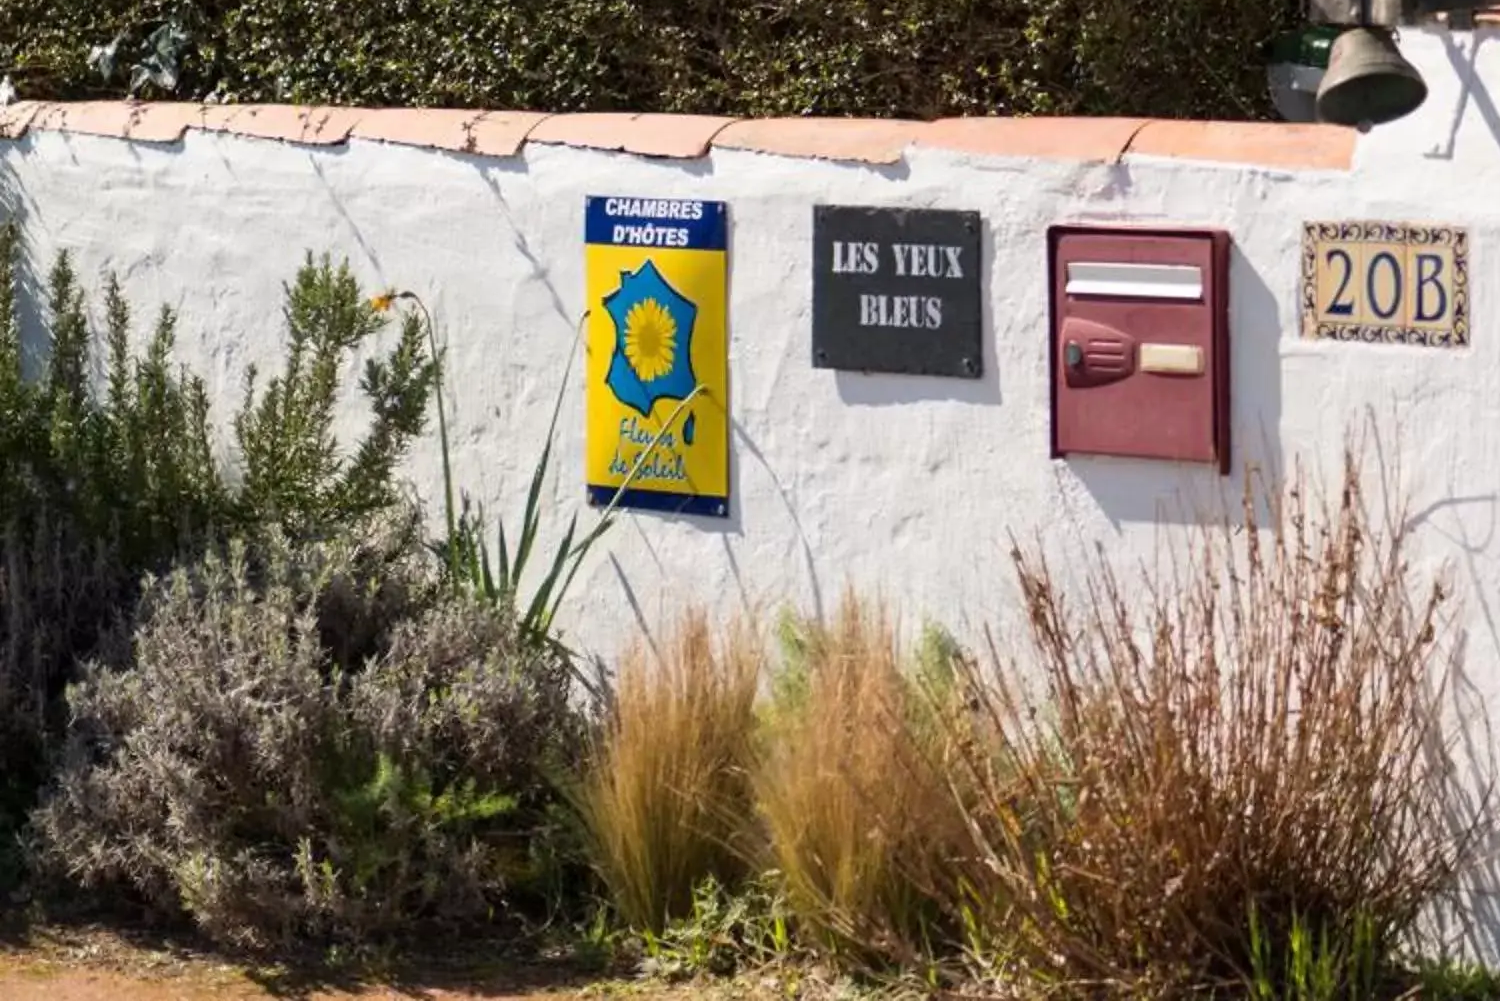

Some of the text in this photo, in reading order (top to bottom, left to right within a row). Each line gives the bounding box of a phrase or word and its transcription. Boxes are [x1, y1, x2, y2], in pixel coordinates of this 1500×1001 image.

[605, 198, 703, 220] CHAMBRES
[612, 222, 689, 246] D'HÔTES
[832, 241, 963, 278] LES YEUX
[1325, 249, 1447, 322] 20B
[860, 294, 942, 329] BLEUS
